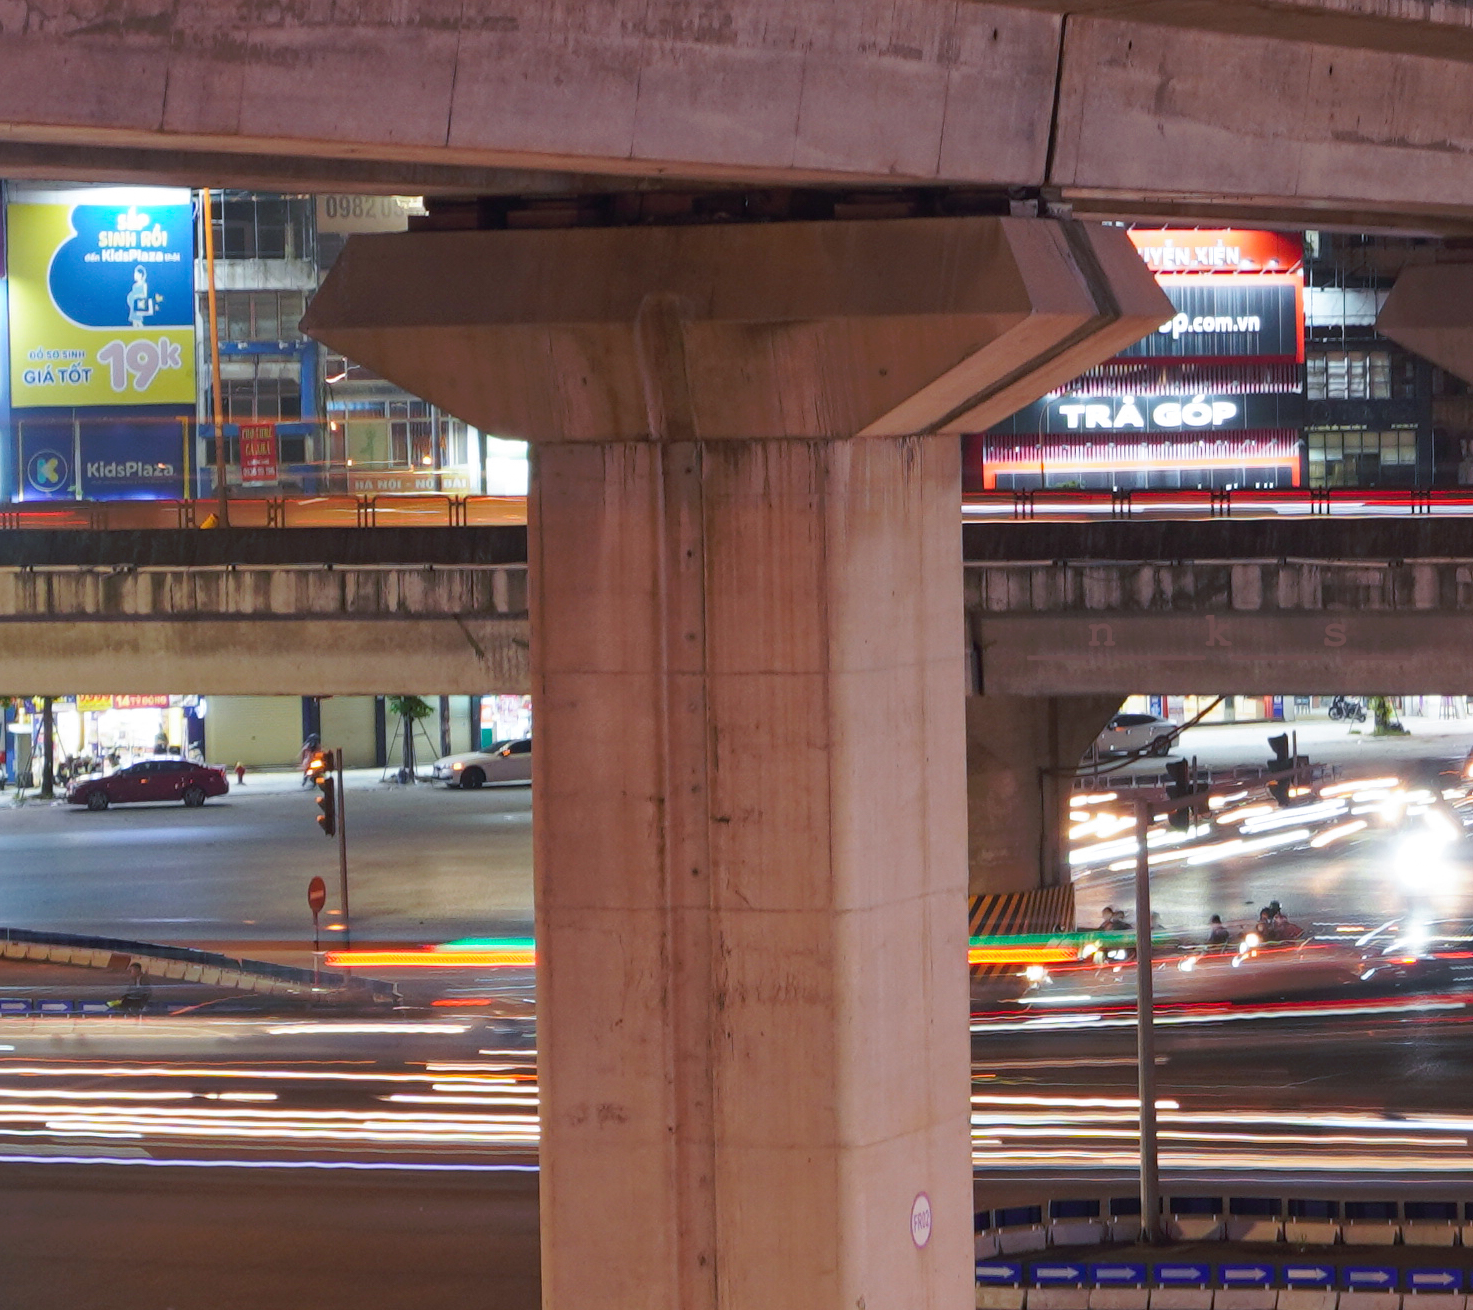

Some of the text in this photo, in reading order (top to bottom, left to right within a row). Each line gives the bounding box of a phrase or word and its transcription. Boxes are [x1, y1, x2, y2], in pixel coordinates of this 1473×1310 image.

[326, 195, 375, 218] 0982
[99, 231, 136, 247] SINH
[24, 364, 55, 384] GIÁ
[57, 361, 92, 384] TỐT
[1153, 394, 1237, 427] GÓP
[87, 461, 174, 478] KidsPlaza
